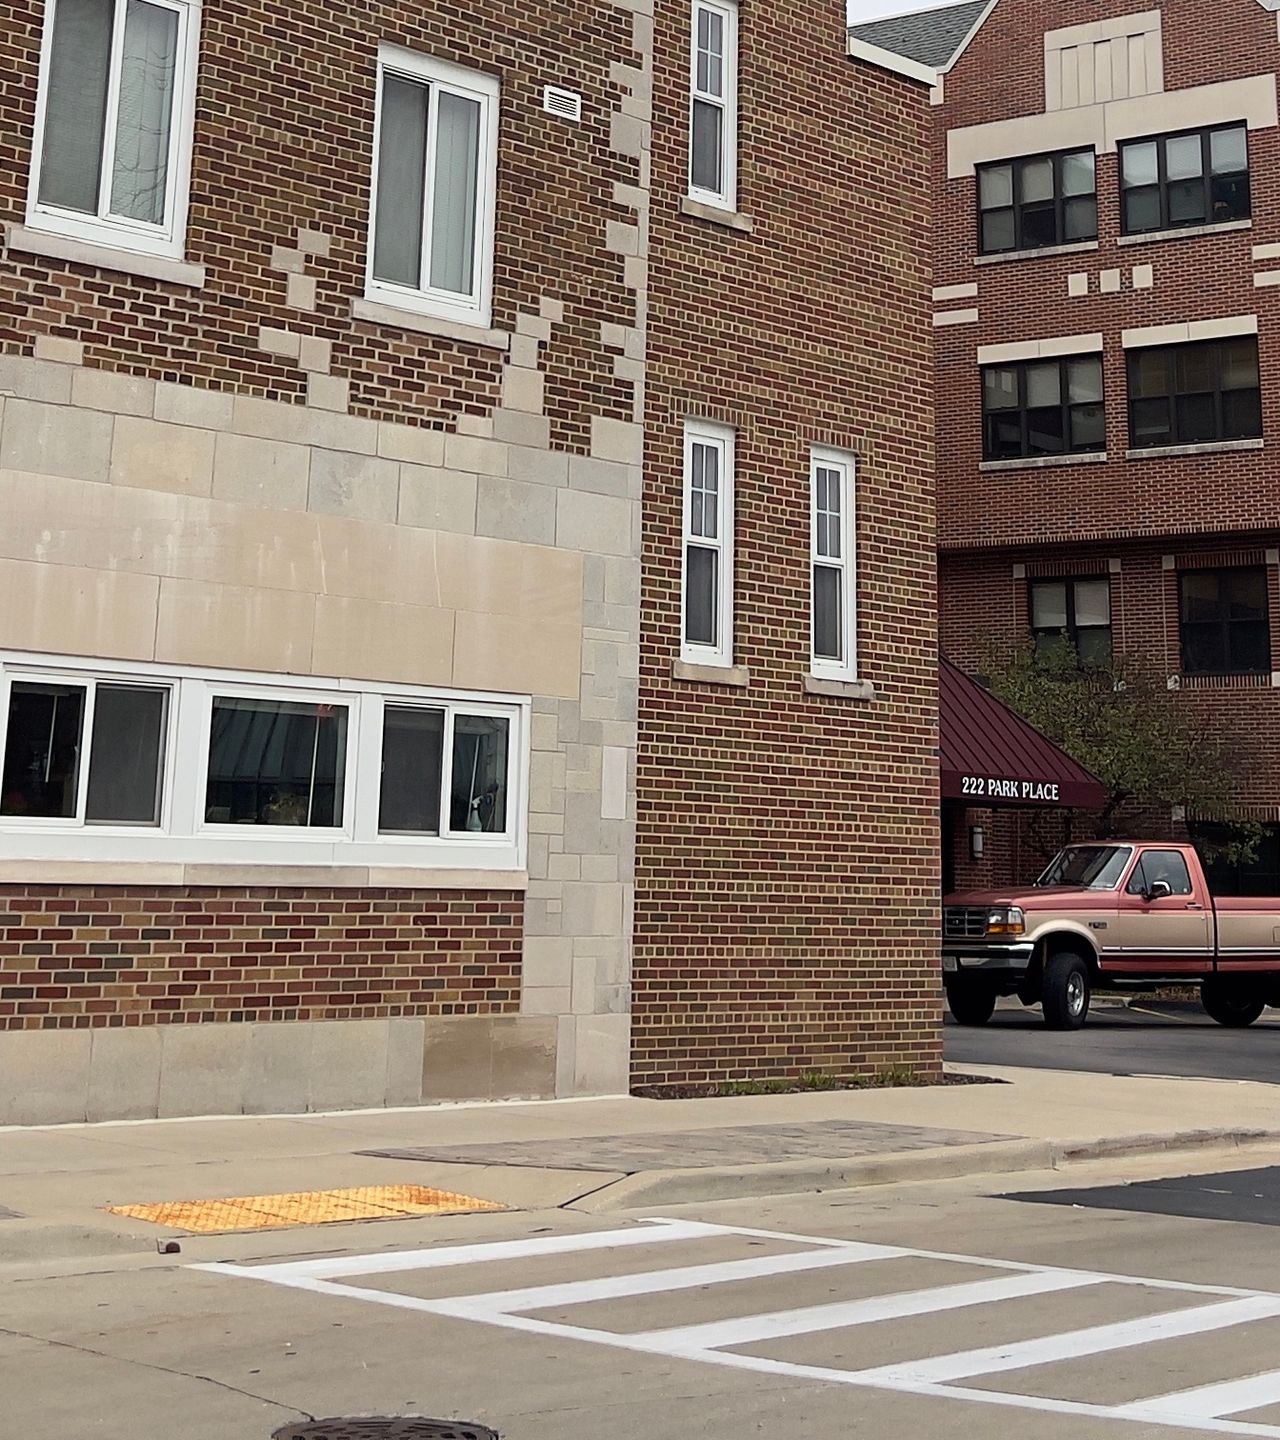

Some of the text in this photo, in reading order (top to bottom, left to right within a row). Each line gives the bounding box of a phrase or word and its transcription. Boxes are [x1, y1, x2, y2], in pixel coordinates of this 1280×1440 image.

[962, 777, 1059, 800] 222 PARK PLACE
